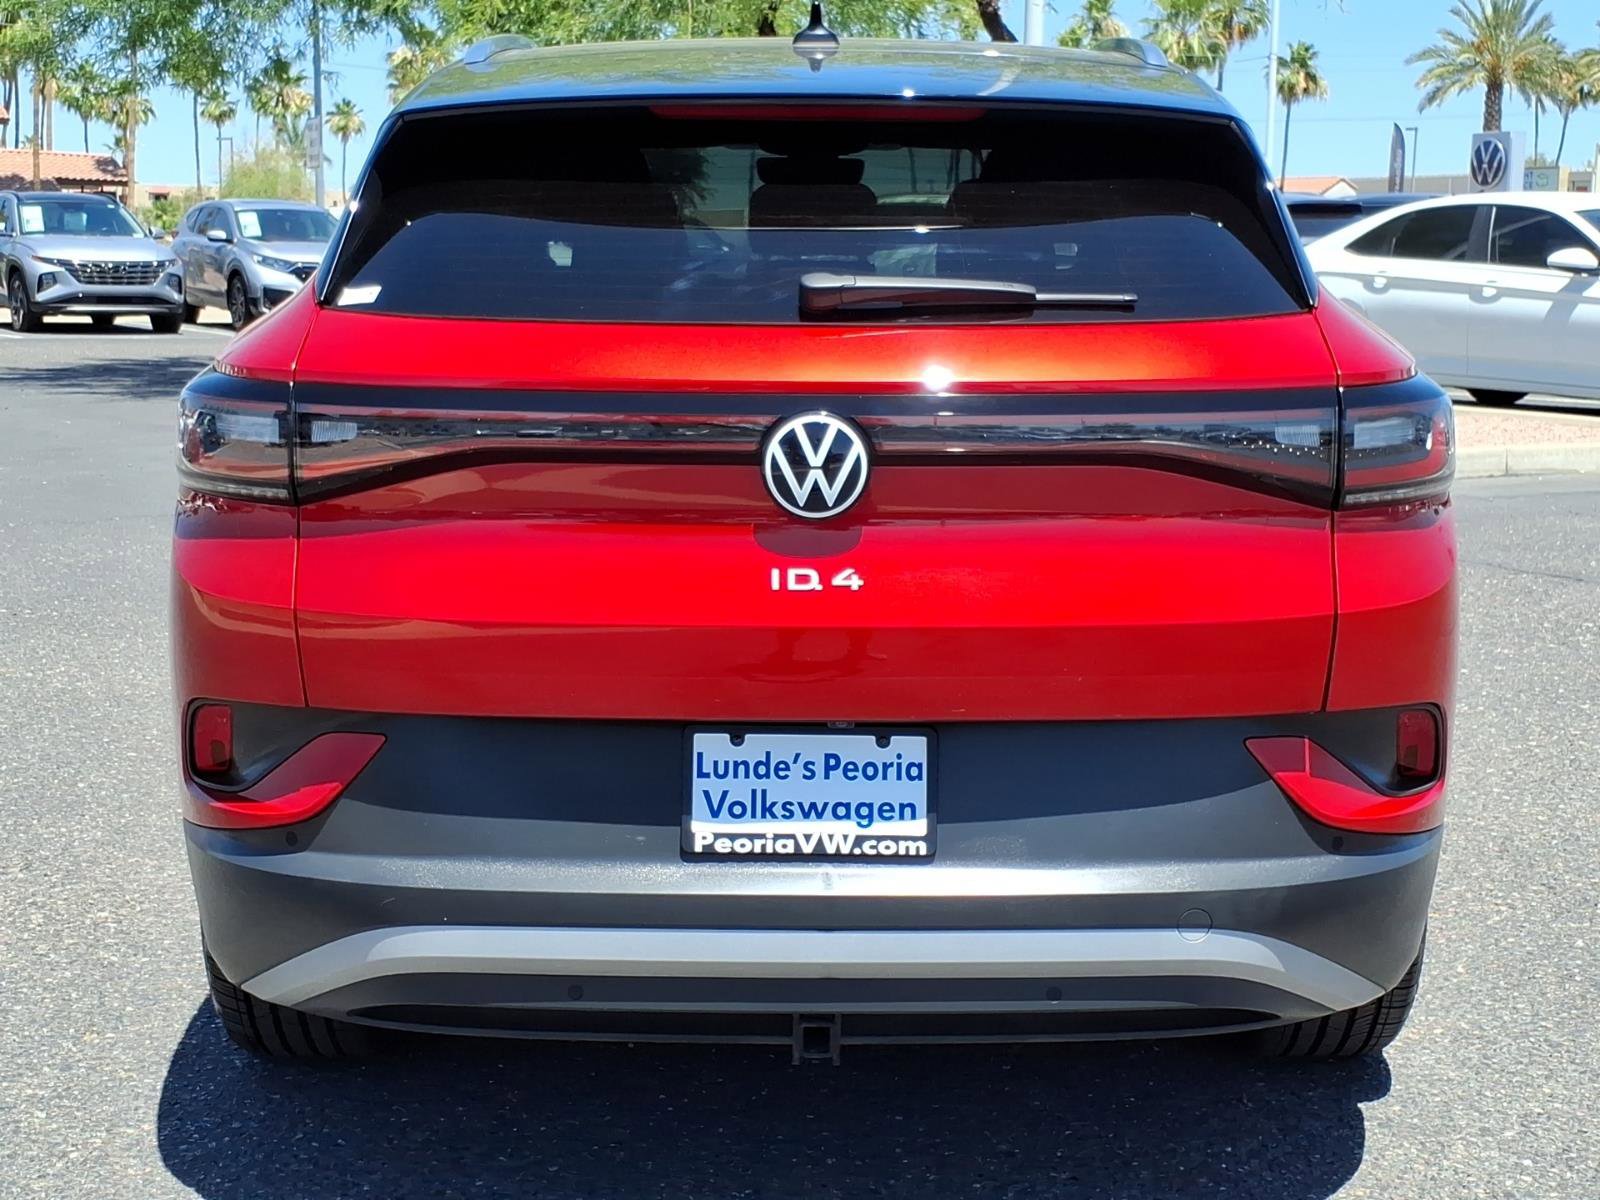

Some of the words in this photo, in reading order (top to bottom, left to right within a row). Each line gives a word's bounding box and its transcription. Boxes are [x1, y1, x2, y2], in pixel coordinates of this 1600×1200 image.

[768, 416, 866, 515] VW
[770, 567, 865, 591] ID.4
[696, 751, 816, 781] Lunde's
[823, 753, 924, 782] Peoria
[702, 788, 917, 828] Volkswagen
[693, 832, 928, 856] PeoriaVW.com
